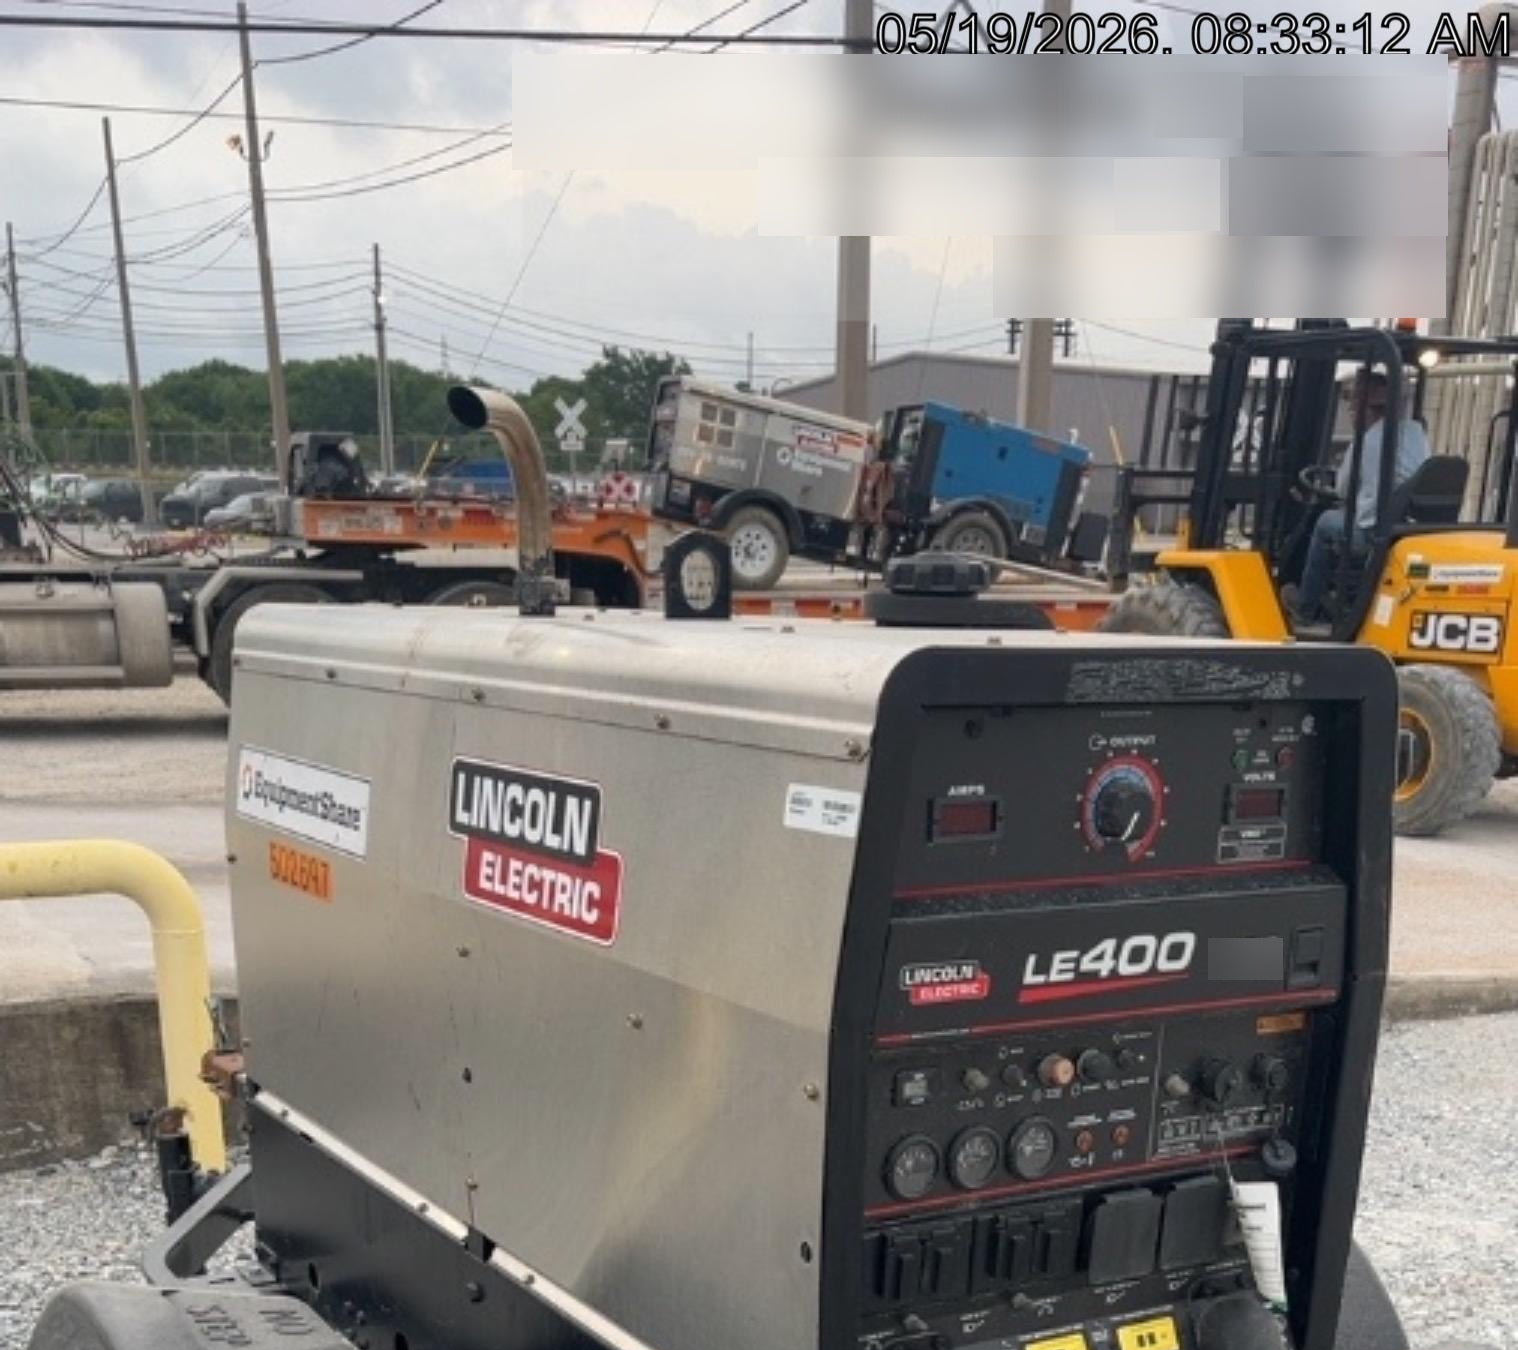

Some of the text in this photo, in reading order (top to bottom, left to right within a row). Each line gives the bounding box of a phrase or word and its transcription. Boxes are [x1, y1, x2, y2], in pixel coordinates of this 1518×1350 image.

[1411, 613, 1500, 652] JCB
[255, 770, 360, 832] EquipmentShare
[455, 772, 593, 857] LINCOLN
[478, 850, 601, 925] ELECTRIC
[904, 965, 974, 985] LINCOLN
[1022, 932, 1196, 985] LE400
